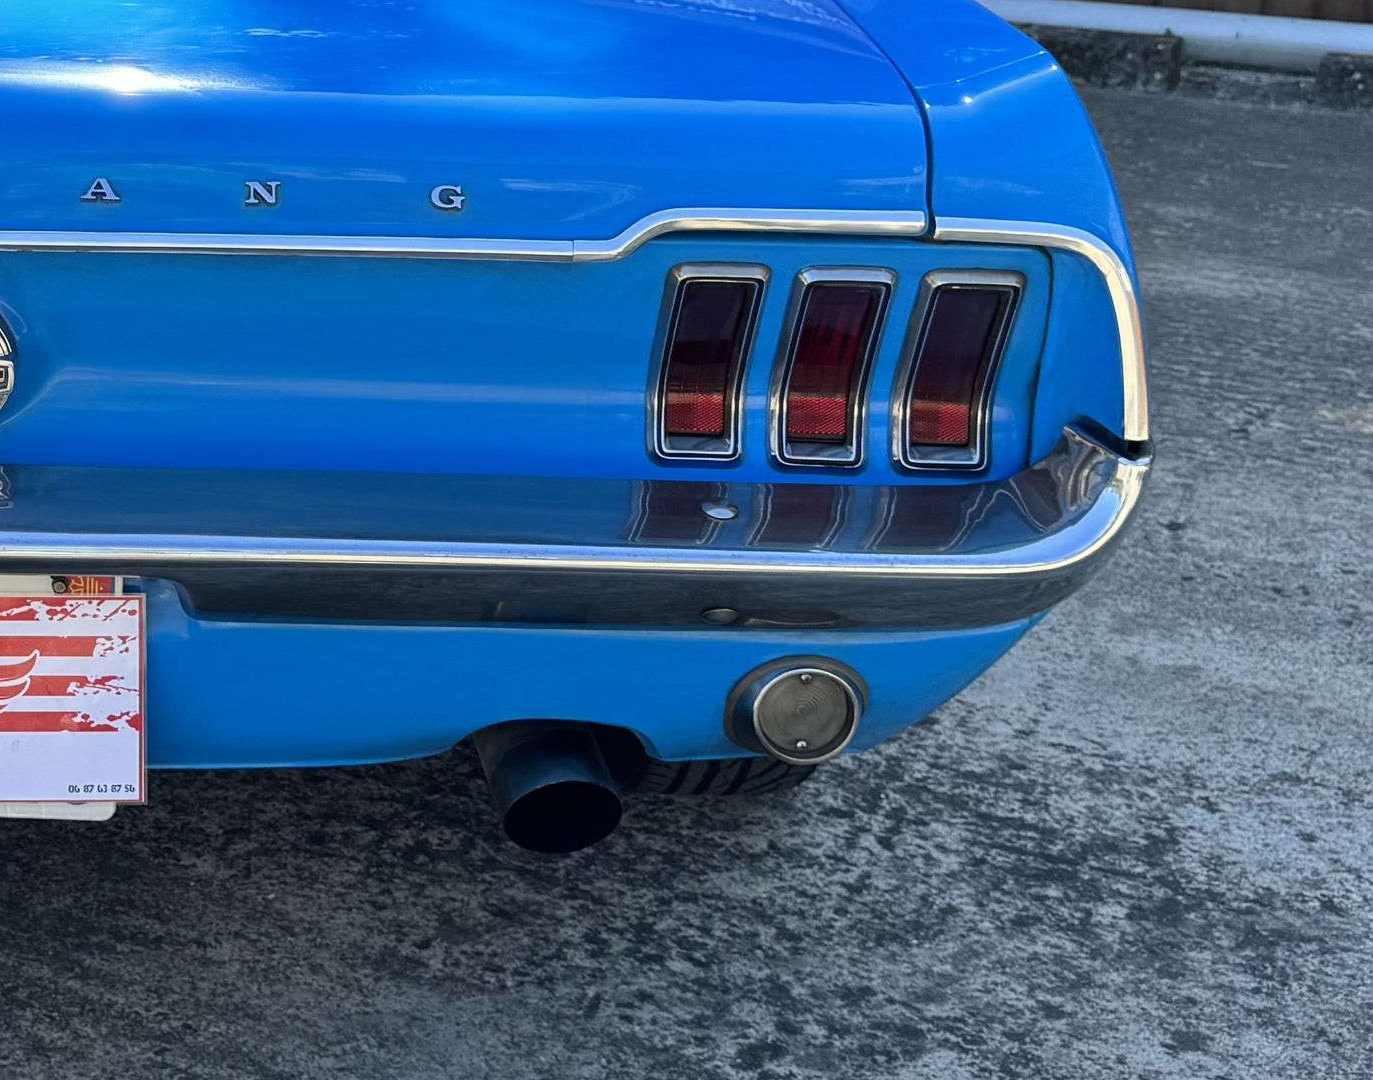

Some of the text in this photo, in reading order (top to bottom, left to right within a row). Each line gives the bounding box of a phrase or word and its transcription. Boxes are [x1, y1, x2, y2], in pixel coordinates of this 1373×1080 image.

[68, 784, 136, 793] 06 87 63 87 56
